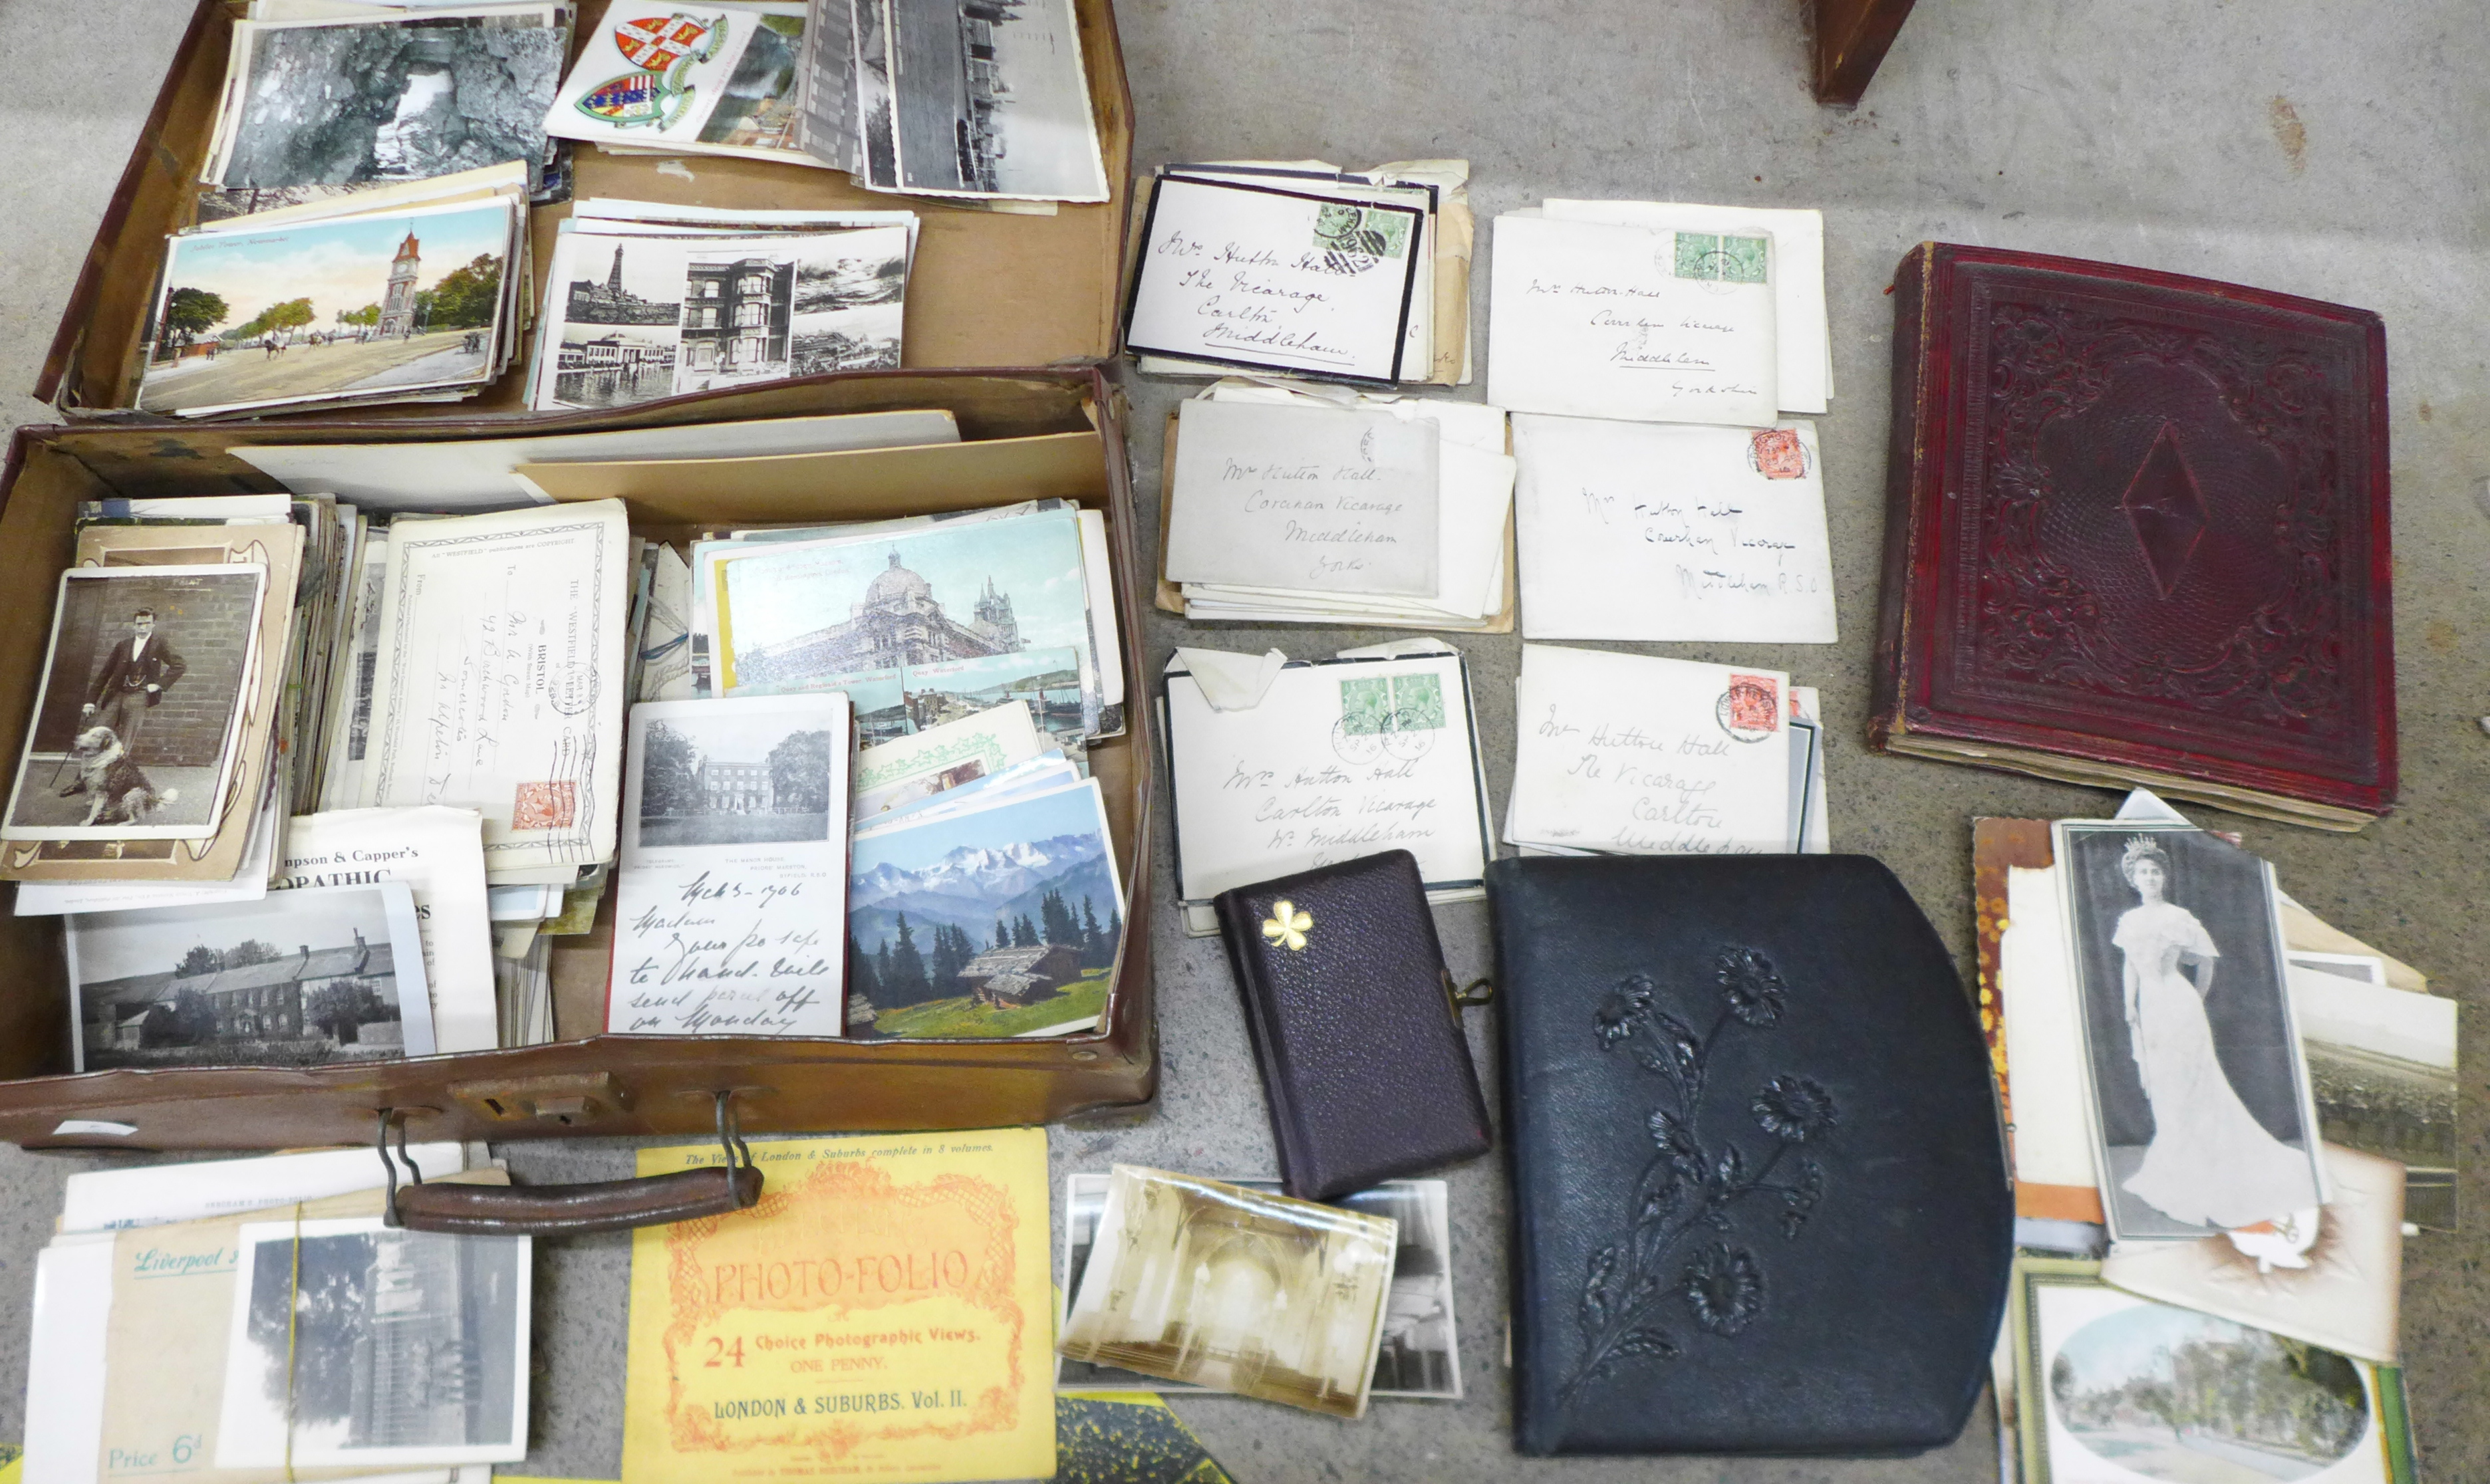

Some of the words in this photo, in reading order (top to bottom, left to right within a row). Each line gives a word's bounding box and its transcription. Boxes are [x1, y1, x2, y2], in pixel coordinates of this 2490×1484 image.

[1179, 270, 1213, 291] The
[537, 538, 575, 548] COPYRIGHT
[506, 564, 517, 576] To
[415, 574, 426, 596] From
[569, 579, 579, 601] THE
[535, 644, 547, 695] BRISTOL
[932, 666, 964, 674] Waterford
[810, 681, 842, 689] Reginald's
[865, 674, 897, 683] Waterford
[561, 726, 571, 757] CARD
[1255, 796, 1343, 824] Carlton
[1358, 795, 1437, 822] Vicarage
[334, 851, 346, 863] &
[352, 846, 419, 862] Capper's
[686, 1153, 705, 1165] The
[710, 1152, 740, 1164] Vies
[760, 1150, 802, 1162] London
[806, 1150, 817, 1160] &
[822, 1147, 867, 1160] Suburbs
[871, 1146, 920, 1159] complete
[922, 1146, 933, 1156] in
[938, 1144, 946, 1154] 8
[950, 1144, 995, 1154] volumes.
[134, 1247, 225, 1273] Liverpool
[713, 1249, 970, 1306] PHOTO-FOLIO
[703, 1336, 746, 1370] 24
[756, 1332, 807, 1351] Choice
[814, 1328, 922, 1348] Photographic
[929, 1326, 981, 1345] Views.
[790, 1358, 823, 1374] ONE
[714, 1400, 787, 1422] LONDON
[793, 1398, 807, 1415] &
[814, 1392, 905, 1415] SUBURBS.
[912, 1390, 945, 1410] Vol.
[108, 1447, 157, 1470] Price
